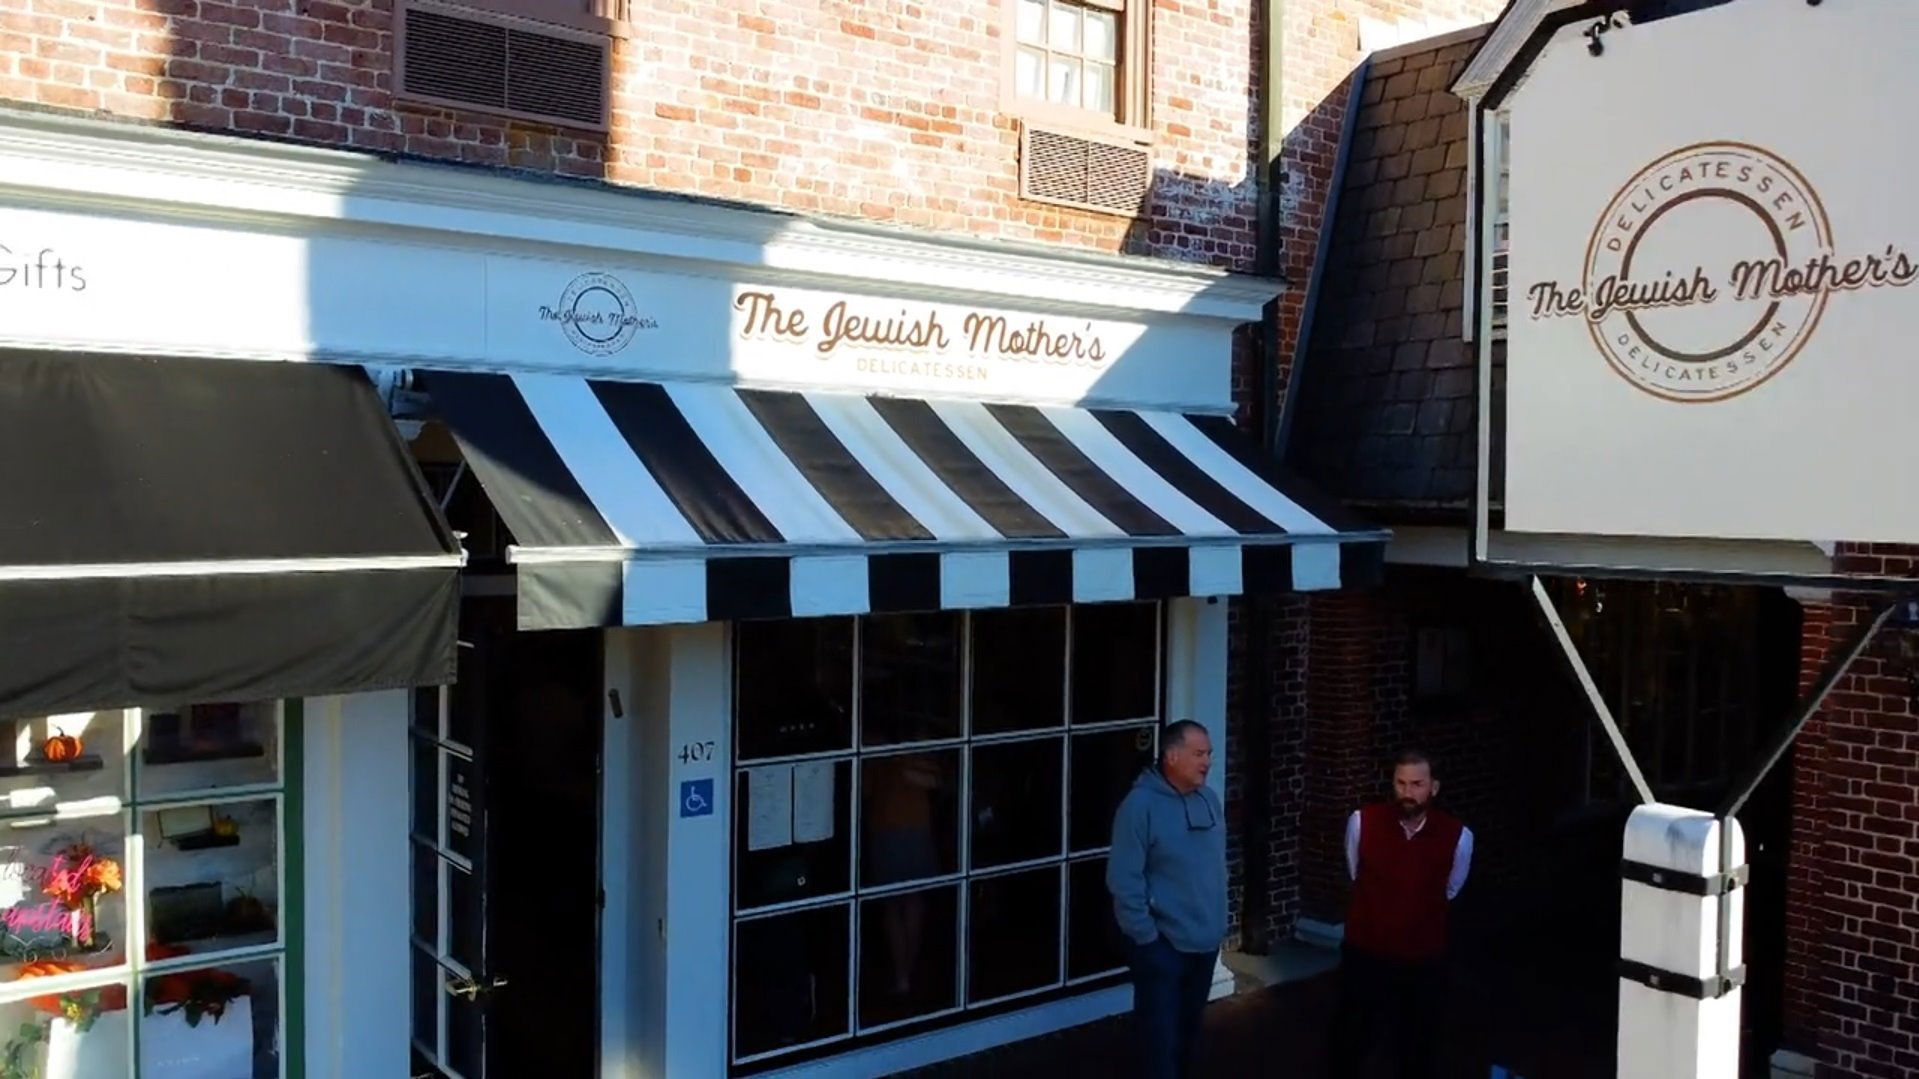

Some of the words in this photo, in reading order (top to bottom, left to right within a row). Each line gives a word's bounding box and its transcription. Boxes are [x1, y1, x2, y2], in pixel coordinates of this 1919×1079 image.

[1606, 160, 1806, 253] DELICATESSEN
[539, 305, 562, 321] The
[1528, 280, 1584, 317] The
[1589, 266, 1717, 320] Jewish
[1731, 244, 1918, 298] Mother's
[735, 291, 809, 337] The
[816, 300, 950, 353] Jewish
[963, 311, 1107, 362] Mother's
[1616, 320, 1788, 382] DELICATESSEN
[855, 357, 989, 381] DELICATESSEN
[677, 740, 715, 765] 407
